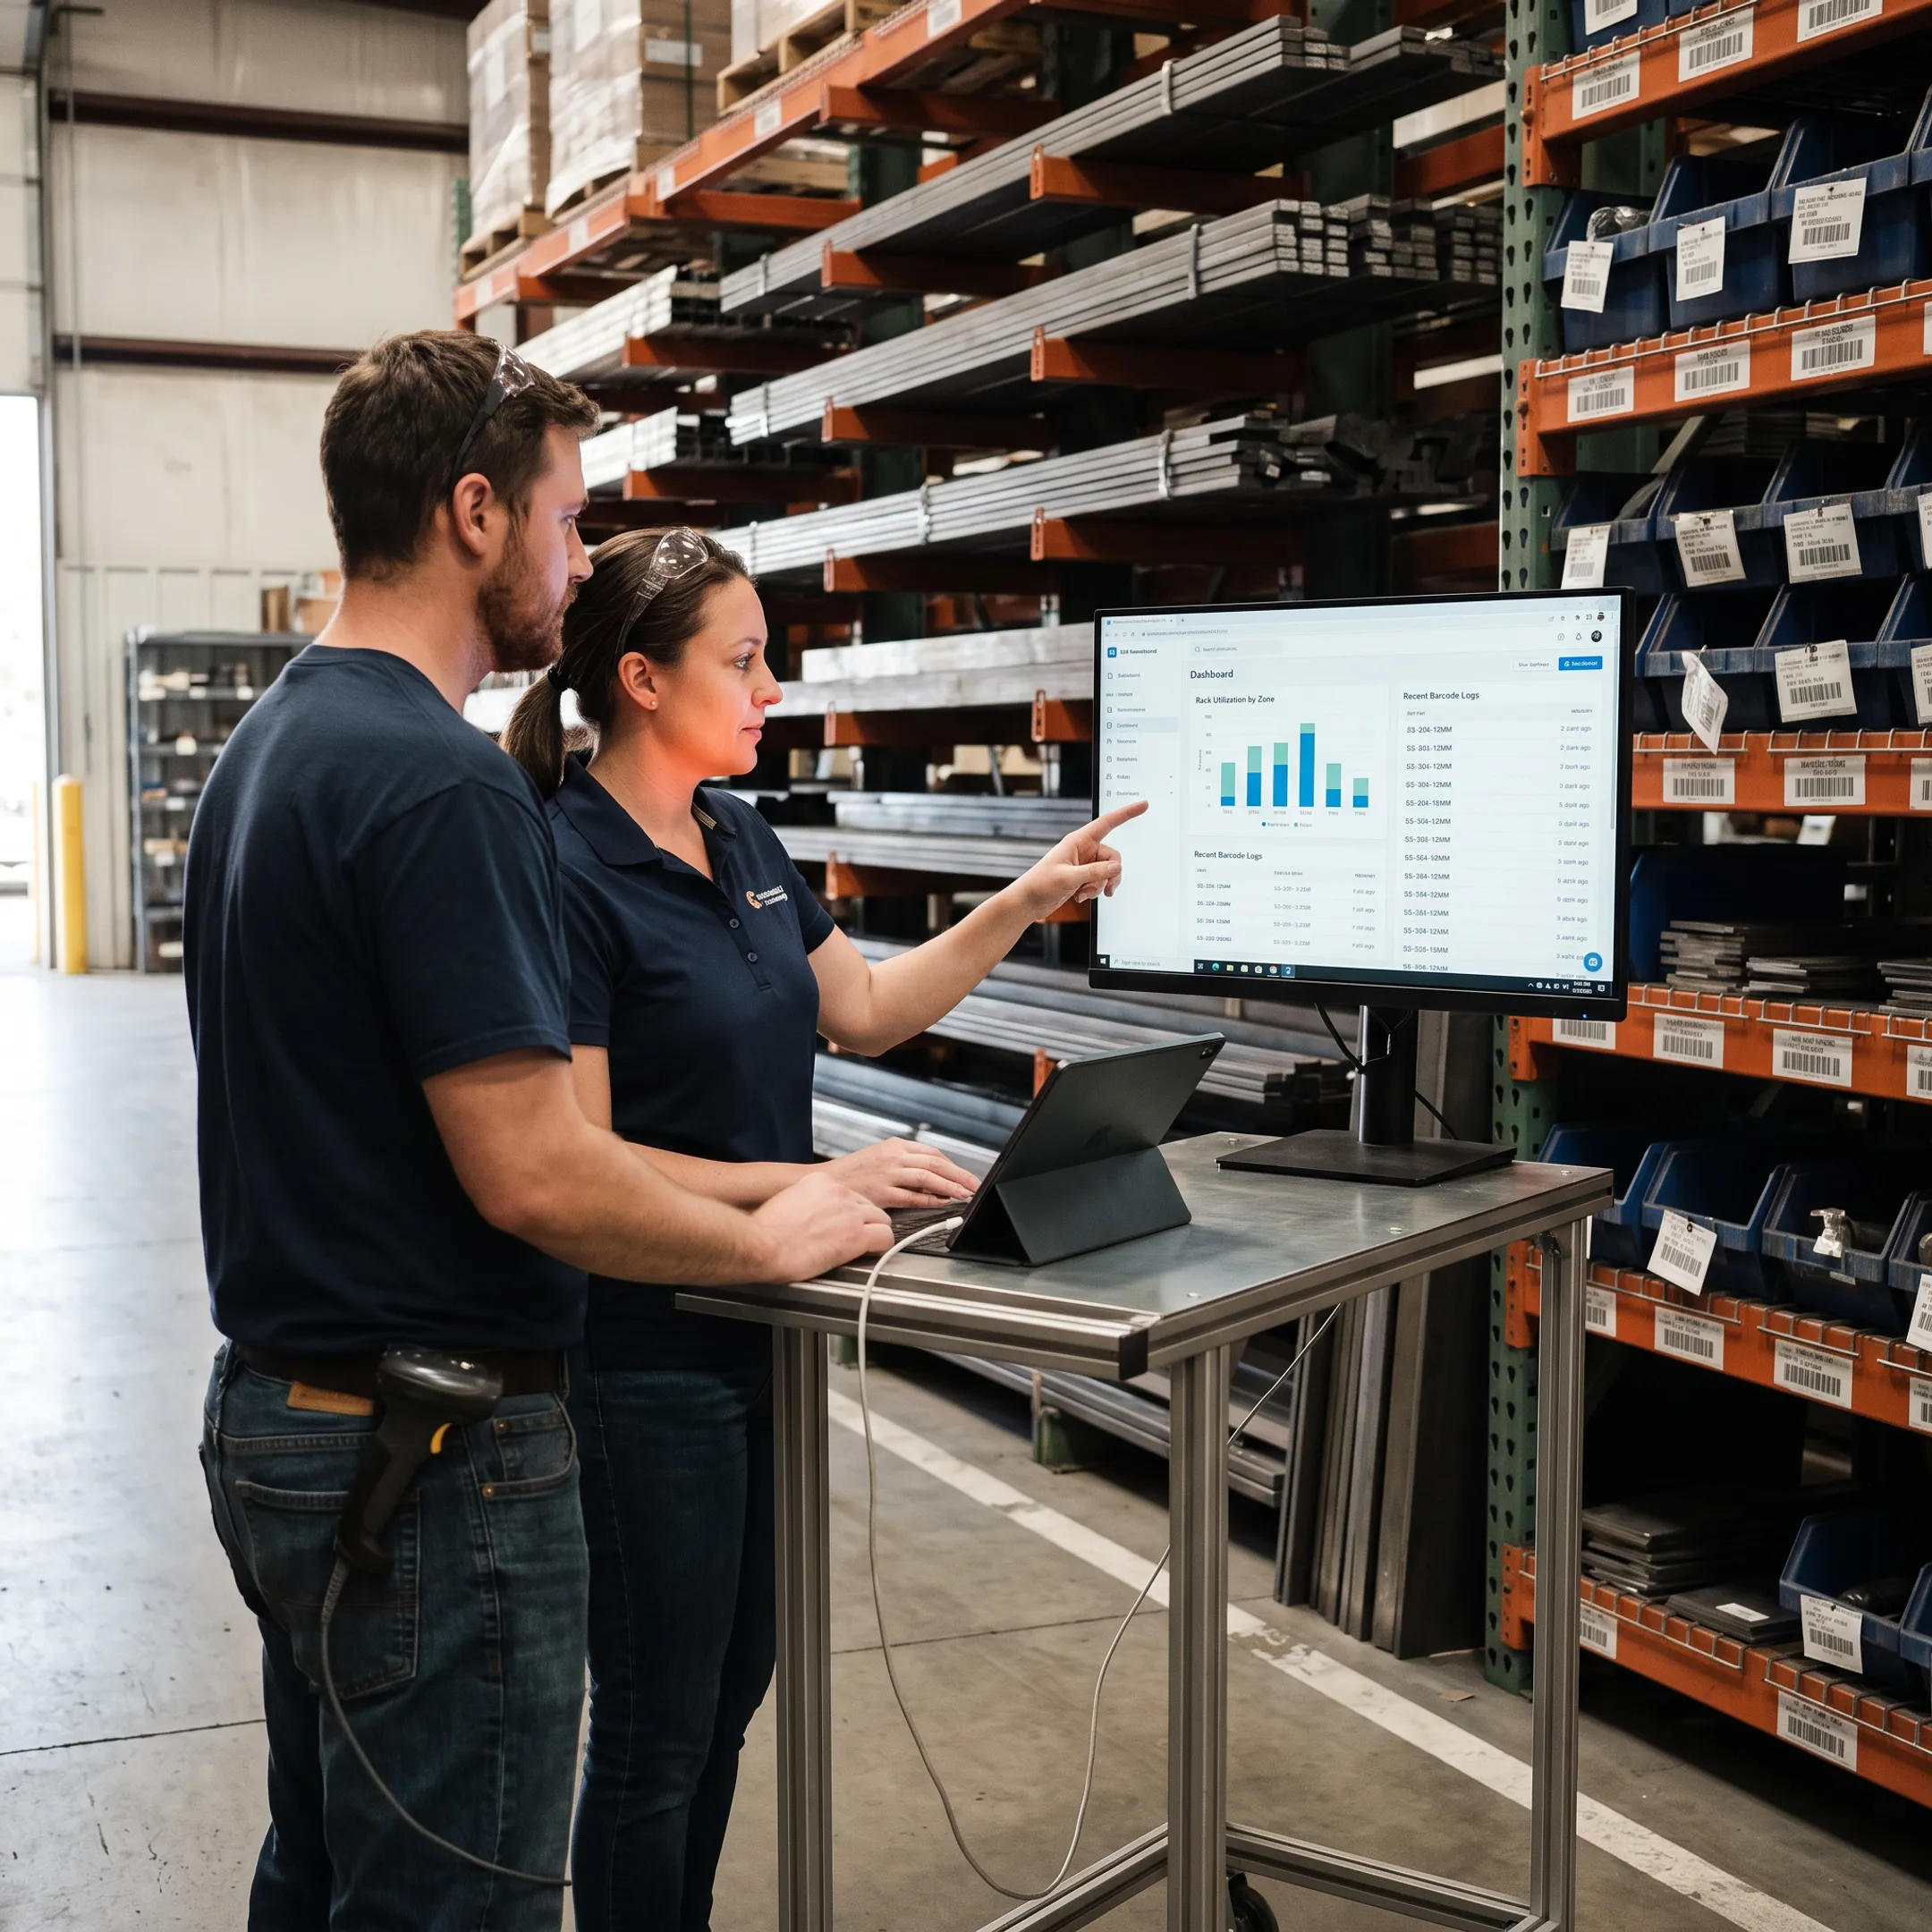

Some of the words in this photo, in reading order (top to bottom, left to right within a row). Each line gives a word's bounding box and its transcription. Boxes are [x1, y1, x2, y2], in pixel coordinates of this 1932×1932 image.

[1190, 669, 1233, 679] Dashboard
[1213, 696, 1246, 704] Utilization
[1248, 696, 1256, 704] by
[1258, 695, 1275, 703] Zone
[1430, 691, 1459, 699] Barcode
[1462, 691, 1479, 700] Logs
[1247, 852, 1263, 860] Logs
